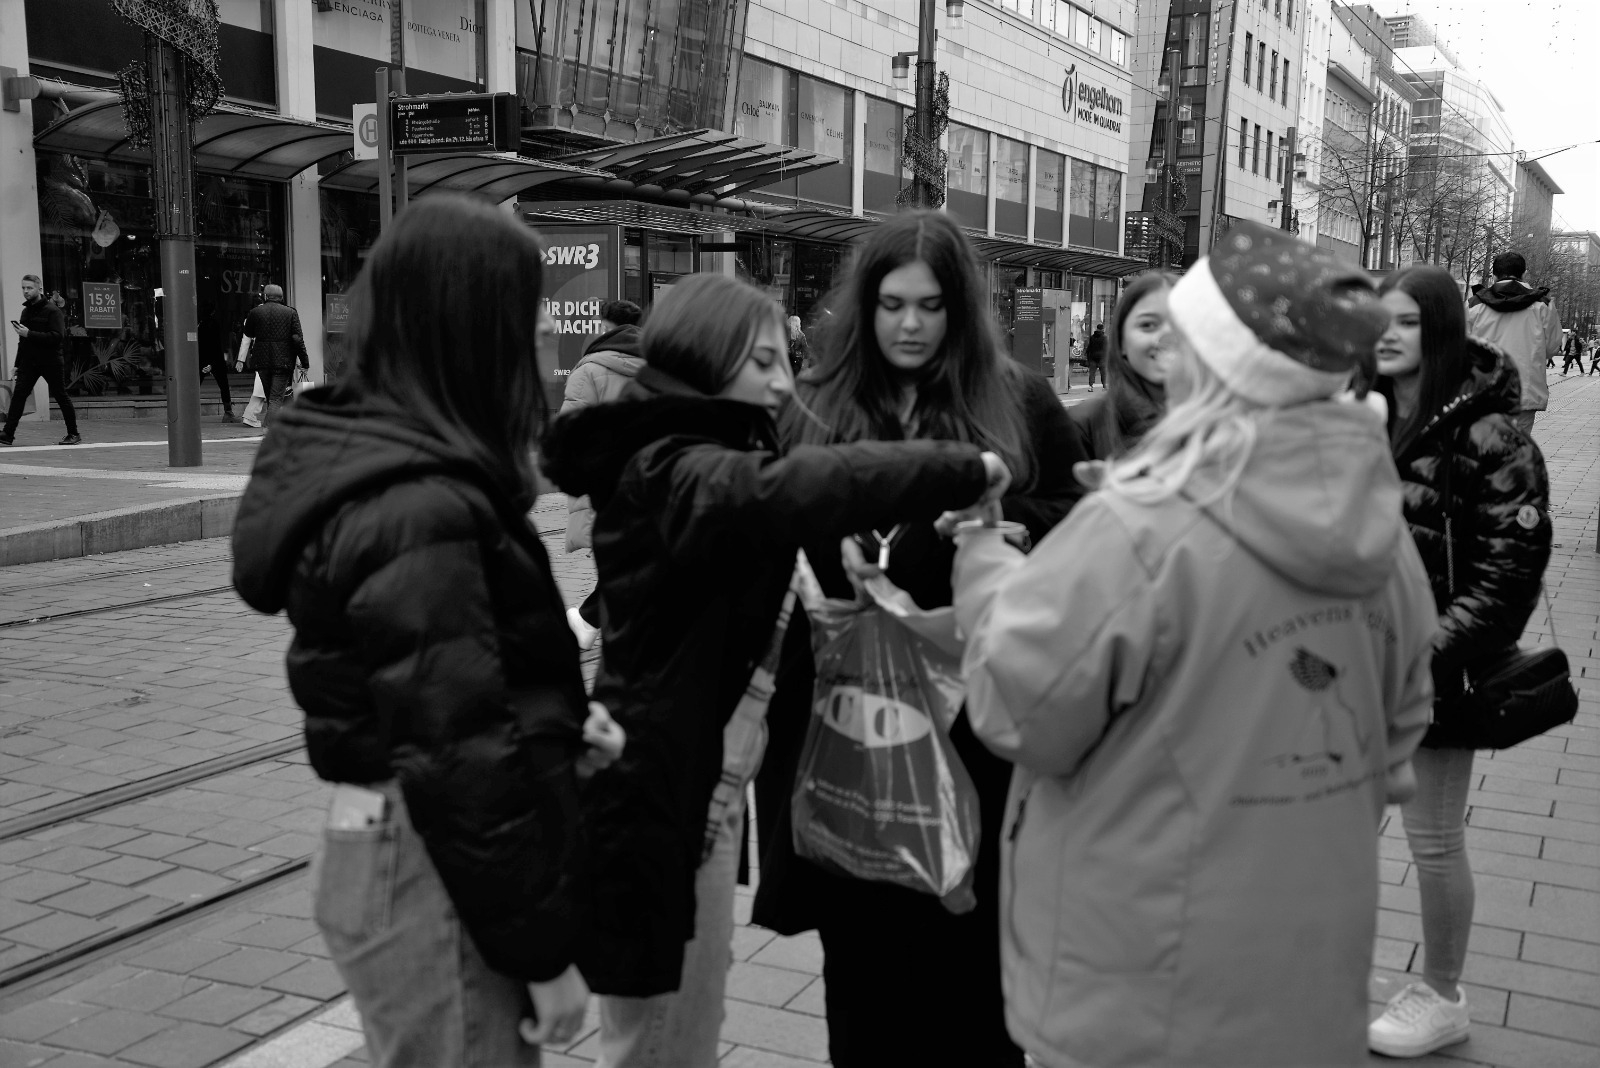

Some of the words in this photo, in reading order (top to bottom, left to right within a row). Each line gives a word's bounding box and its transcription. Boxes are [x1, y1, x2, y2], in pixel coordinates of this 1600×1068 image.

[407, 21, 437, 37] BOTTEGA
[437, 29, 461, 43] VENETA
[459, 15, 484, 35] Dior
[397, 102, 429, 111] Strohmarkt
[759, 99, 780, 112] BALMAIN
[1078, 81, 1123, 117] engelhorn
[741, 101, 760, 118] Chloé
[1077, 107, 1093, 124] MODE
[1099, 115, 1122, 134] QUADRAT
[546, 243, 600, 270] SWR3
[564, 301, 600, 316] DICH
